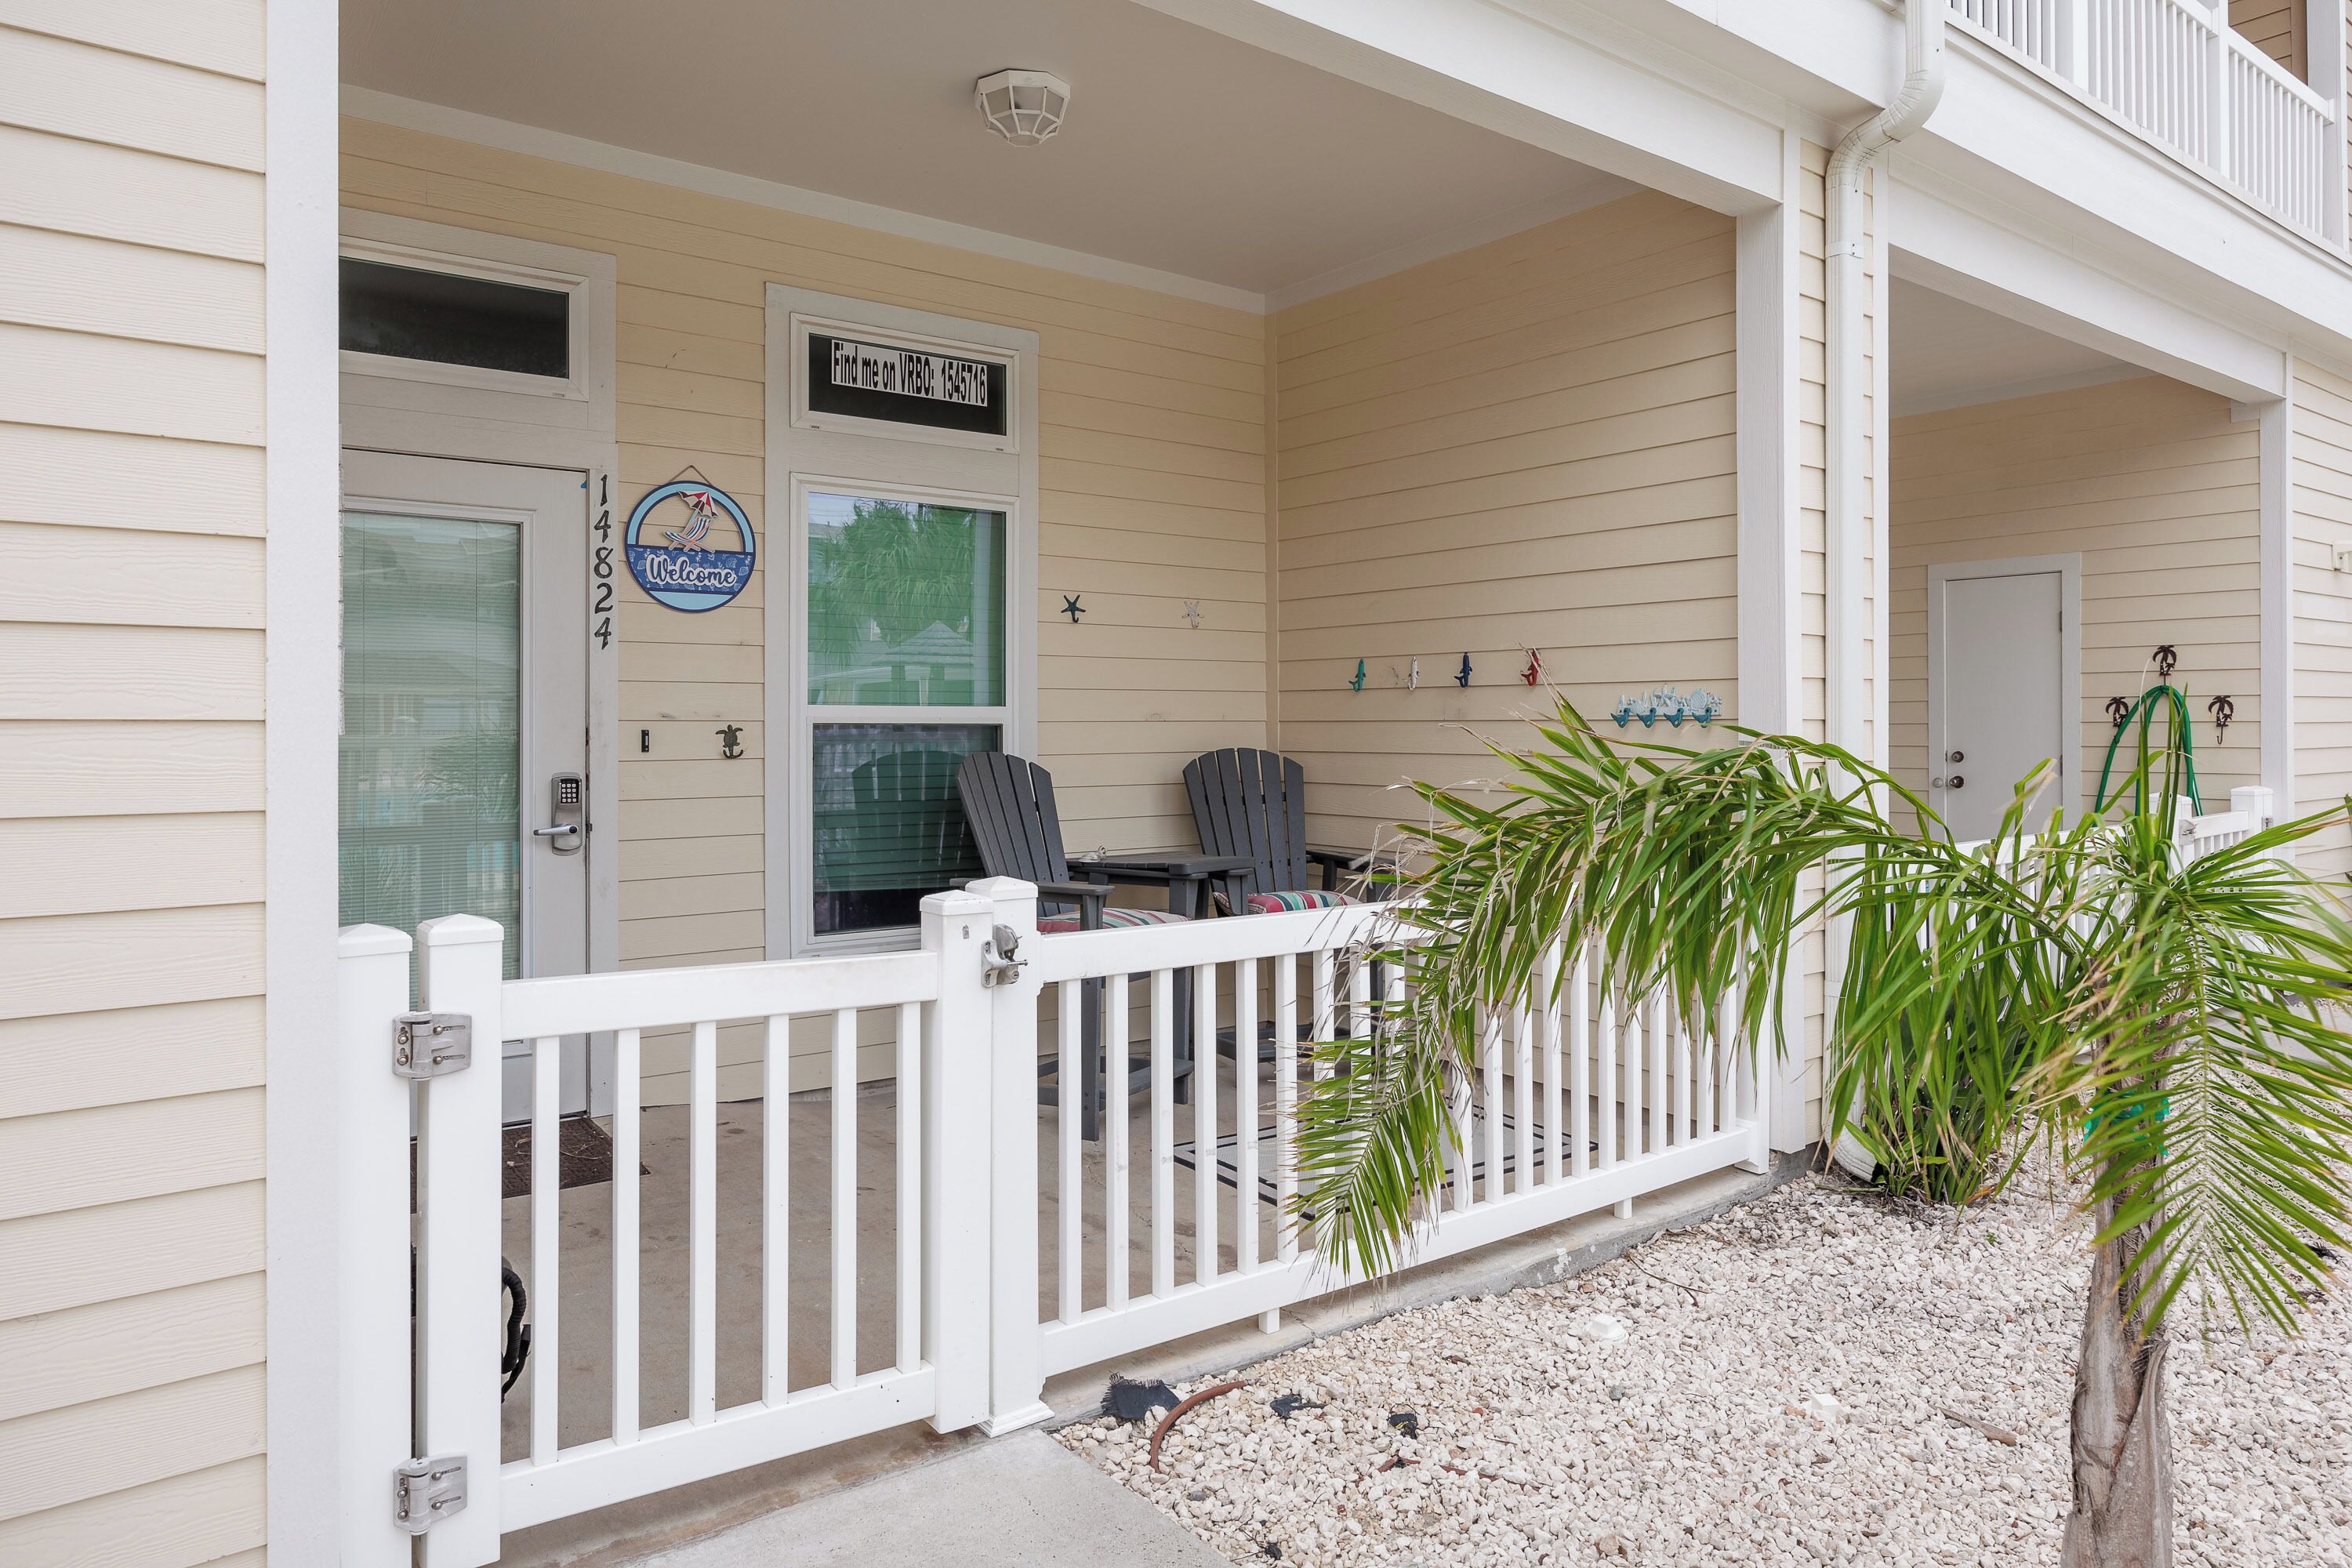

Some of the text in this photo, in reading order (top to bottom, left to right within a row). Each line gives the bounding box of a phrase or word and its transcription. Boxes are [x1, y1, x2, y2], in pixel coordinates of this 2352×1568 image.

[833, 342, 986, 405] Find me on VRBO: 1545716
[593, 474, 614, 650] 14824
[646, 554, 736, 588] Welcome
